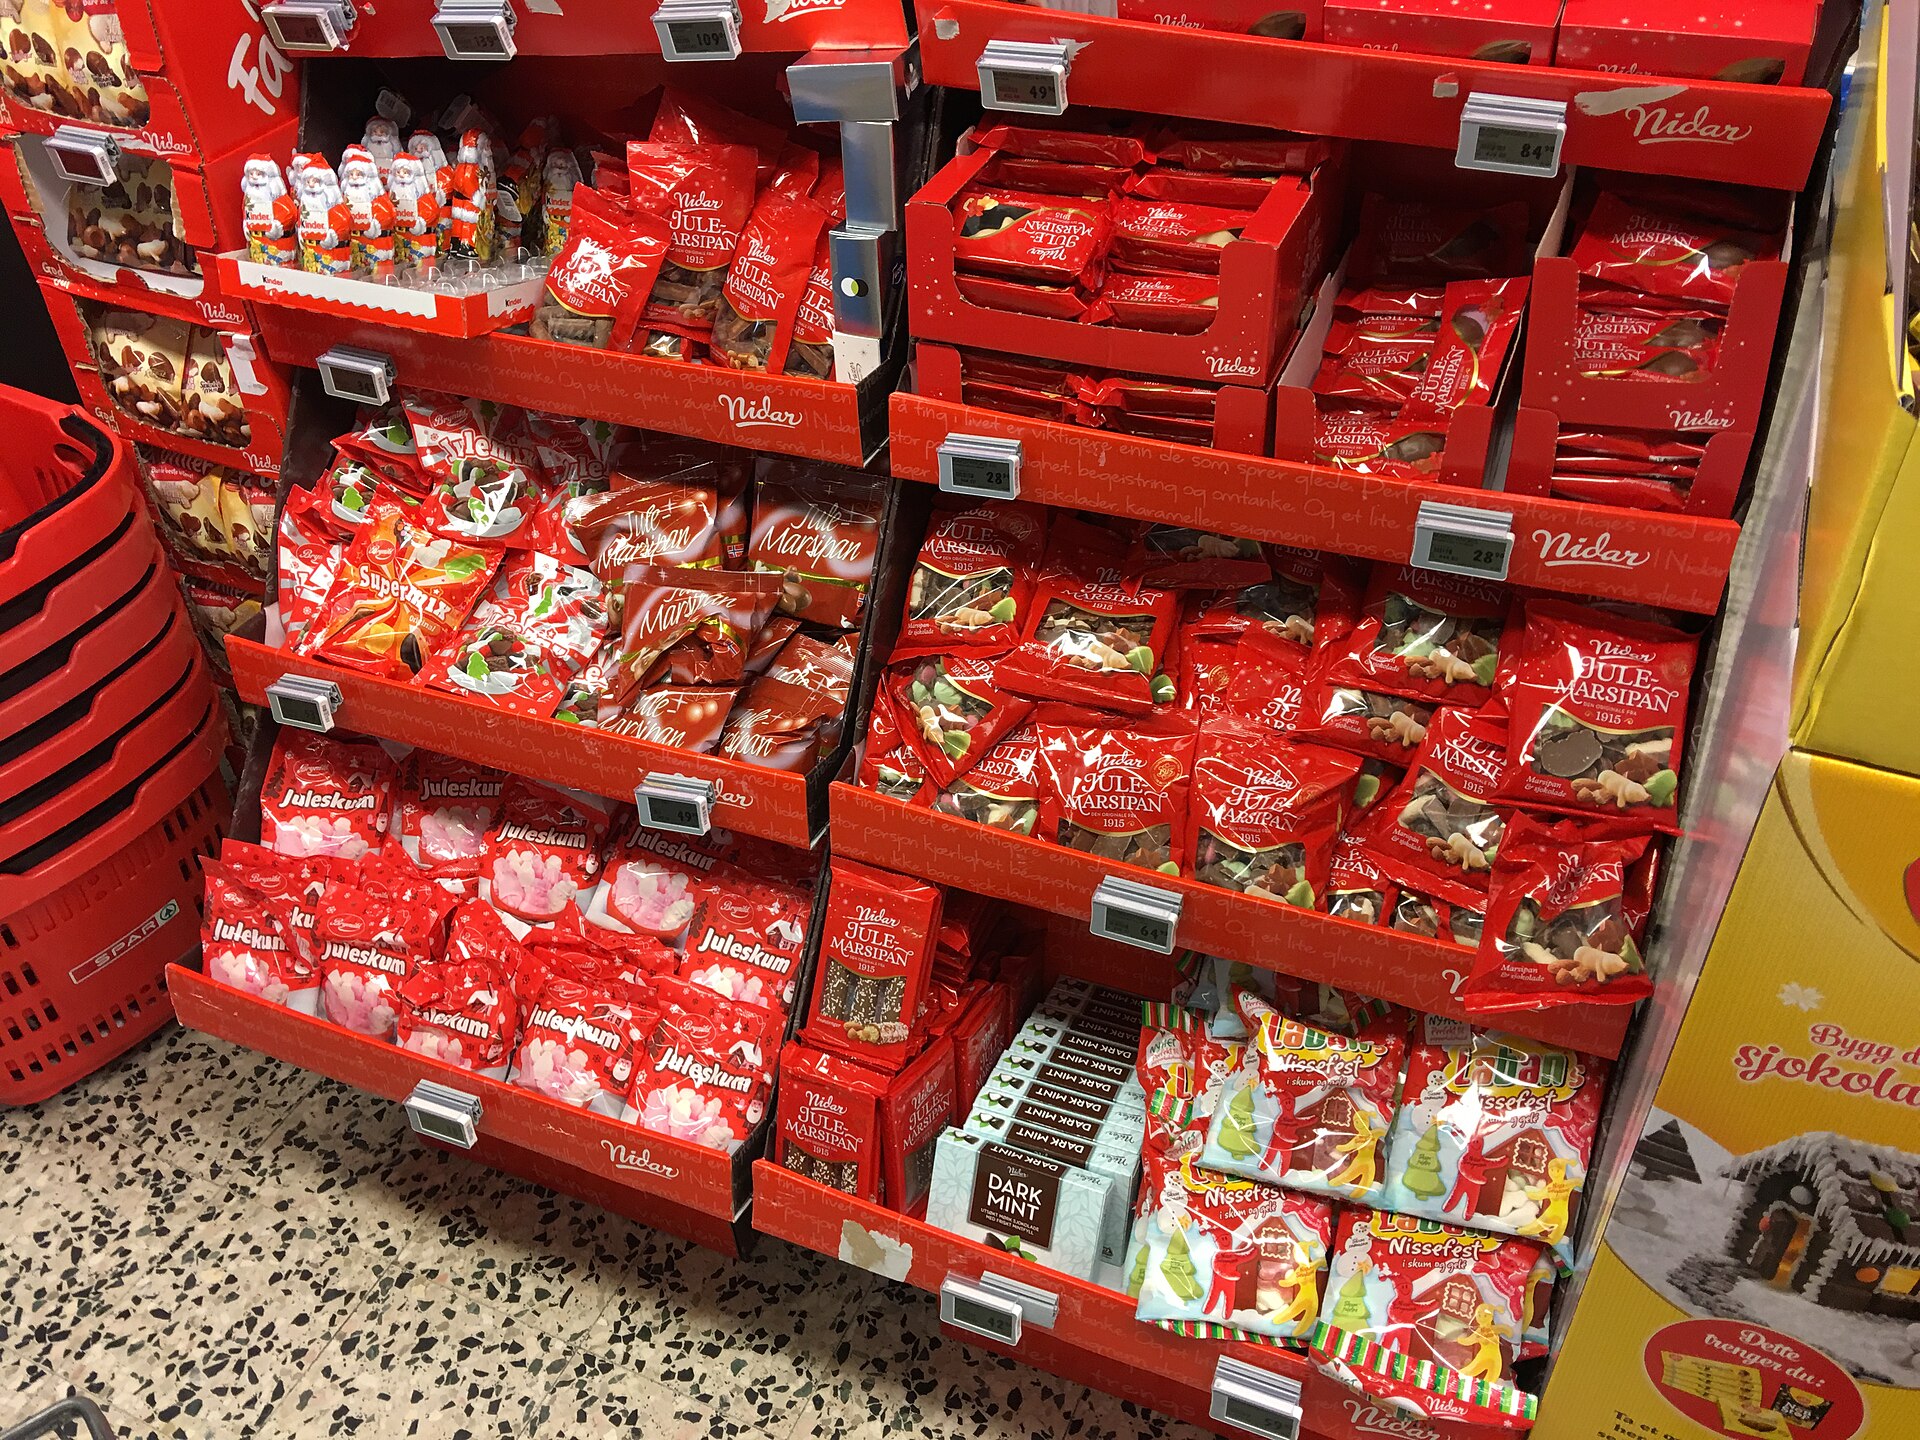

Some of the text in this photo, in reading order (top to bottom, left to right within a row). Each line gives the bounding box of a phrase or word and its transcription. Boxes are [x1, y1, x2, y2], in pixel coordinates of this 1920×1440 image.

[1626, 106, 1753, 144] Nidar
[142, 132, 192, 155] Nidar
[673, 190, 723, 211] Nidar
[685, 255, 705, 265] 1915
[749, 240, 779, 265] Nidar
[196, 300, 244, 323] Nidar
[567, 293, 585, 309] 1915
[1204, 355, 1261, 378] Nidar
[718, 394, 803, 429] Nidar
[1669, 409, 1736, 431] Nidar
[758, 525, 862, 569] Marsipan
[920, 537, 1015, 560] MARSIPAN
[1531, 529, 1651, 570] Nidar
[953, 562, 974, 572] 1915
[359, 565, 451, 622] Supermix
[1091, 602, 1114, 611] 1915
[1589, 639, 1657, 663] Nidar
[1554, 679, 1679, 713] MARSIPAN
[1595, 711, 1622, 725] 1915
[1096, 750, 1148, 770] Nidar
[1243, 767, 1298, 791] Nidar
[1463, 779, 1484, 795] 1915
[1525, 775, 1562, 789] Marsipan
[279, 789, 375, 810] Juleskum
[1065, 790, 1169, 816] MARSIPAN
[497, 820, 586, 849] Juleskum
[1103, 818, 1125, 828] 1915
[1240, 833, 1261, 843] 1915
[855, 905, 901, 928] Nidar
[94, 921, 157, 968] SPAR
[697, 928, 792, 973] Juleskum
[830, 936, 914, 967] MARSIPAN
[321, 941, 407, 976] Juleskum
[858, 962, 876, 973] 1915
[1501, 964, 1538, 975] Marsipan
[529, 1003, 622, 1050] Juleskum
[1068, 1036, 1132, 1059] DARK MINT
[1810, 1023, 1895, 1065] Bygg
[655, 1046, 752, 1092] Juleskum
[1057, 1051, 1123, 1076] DARK MINT
[1045, 1067, 1112, 1092] DARK MINT
[806, 1090, 848, 1114] Nidar
[1035, 1088, 1102, 1112] DARK MINT
[1023, 1106, 1092, 1132] DARK MINT
[785, 1119, 863, 1153] MARSIPAN
[1016, 1127, 1085, 1154] DARK MINT
[600, 1140, 680, 1180] Nidar
[813, 1145, 830, 1157] 1915
[990, 1145, 1059, 1172] DARK MINT
[988, 1173, 1043, 1206] DARK
[987, 1190, 1040, 1221] MINT
[1389, 1237, 1484, 1261] Nissefest
[1407, 1259, 1432, 1269] skum
[1739, 1328, 1801, 1363] Dette
[1704, 1331, 1826, 1388] trenger du:
[1426, 1395, 1468, 1416] Nidar
